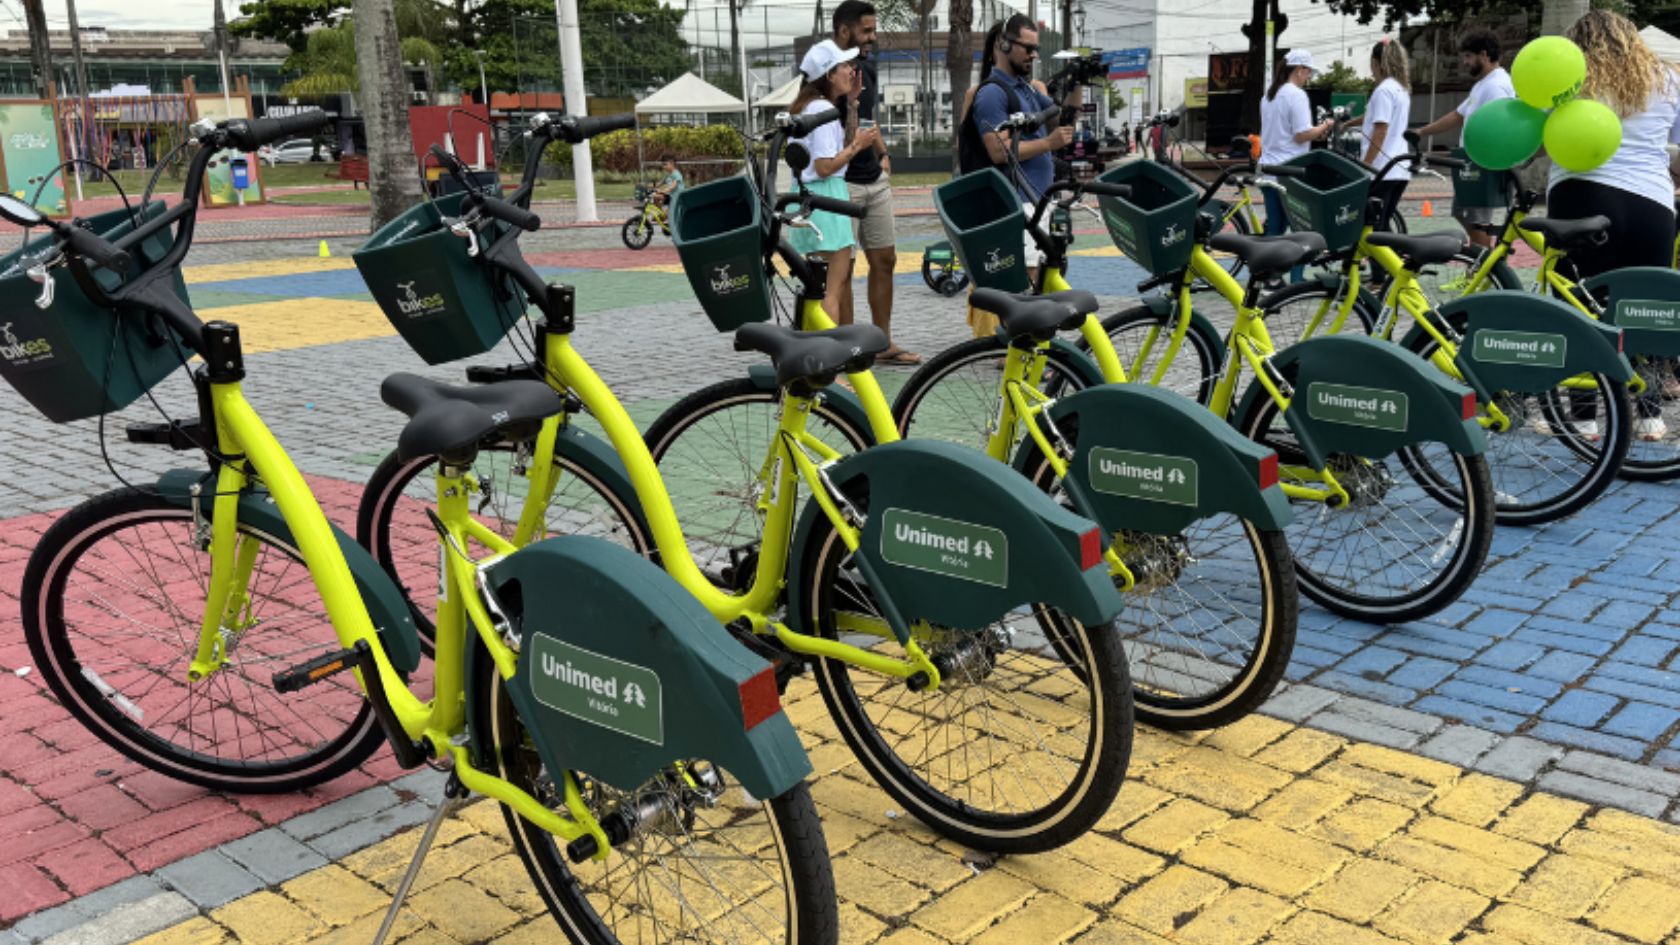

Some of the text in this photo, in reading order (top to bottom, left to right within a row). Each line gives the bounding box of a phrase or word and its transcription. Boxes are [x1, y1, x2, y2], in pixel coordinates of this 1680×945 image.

[711, 274, 749, 291] bikes
[397, 293, 444, 313] bikes
[1624, 306, 1675, 319] Unimed
[1483, 337, 1538, 352] Unimed
[1318, 391, 1378, 411] Unimed
[1100, 458, 1163, 482] Unimed
[894, 523, 969, 554] Unimed
[541, 652, 618, 700] Unimed
